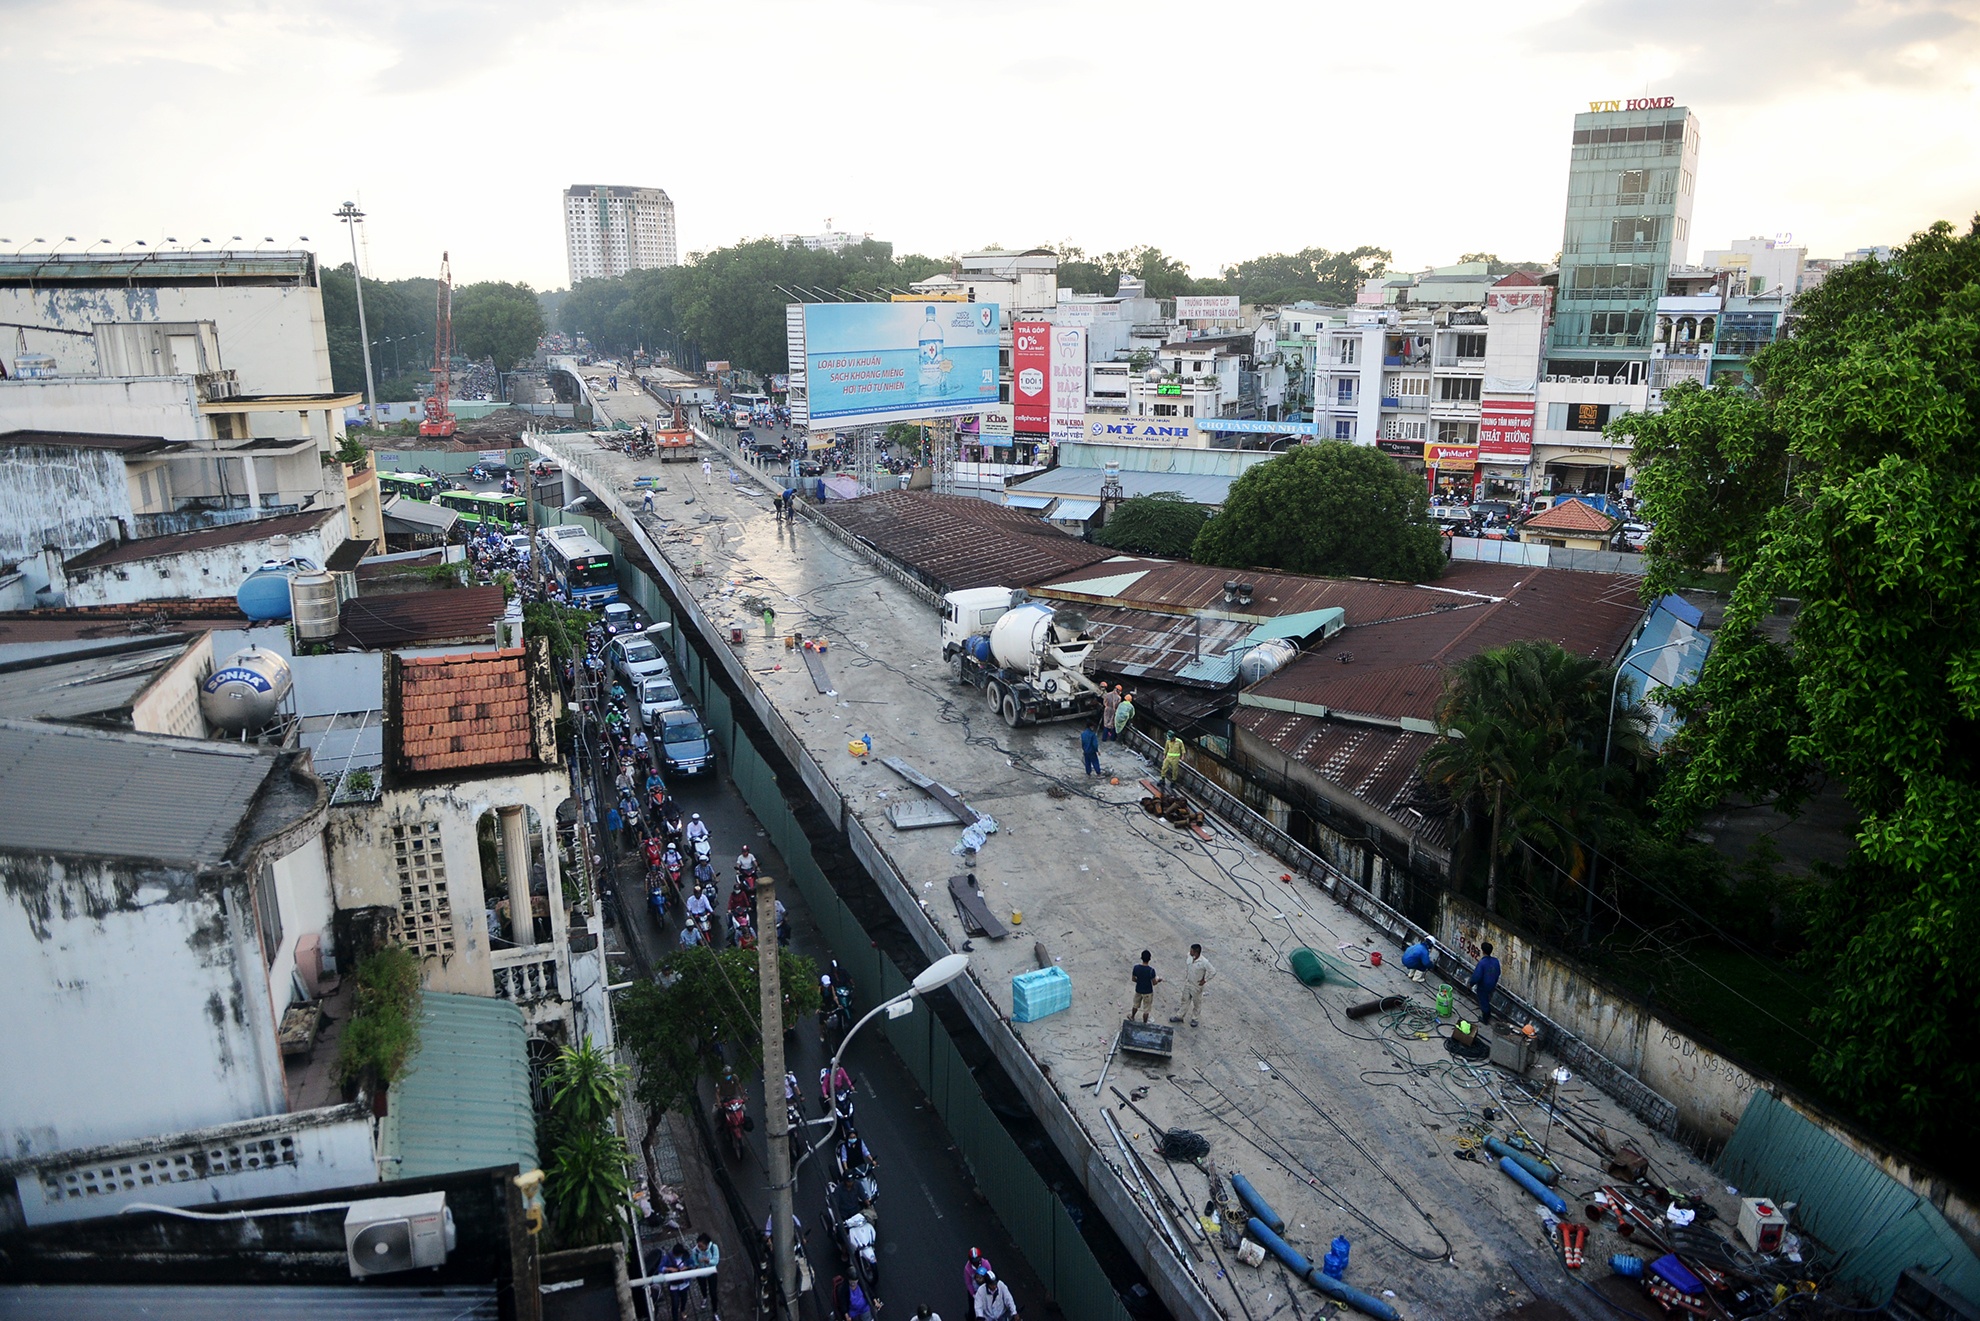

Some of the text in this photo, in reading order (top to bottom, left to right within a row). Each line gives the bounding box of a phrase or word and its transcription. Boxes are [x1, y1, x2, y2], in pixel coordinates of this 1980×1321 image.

[1589, 96, 1675, 112] WIN HOME
[1203, 298, 1219, 306] TRUNG
[1228, 307, 1239, 317] GÒN
[1018, 326, 1045, 334] TRẢ GÓP
[817, 359, 835, 371] LOẠI
[848, 358, 856, 367] VI
[830, 368, 905, 384] SẠCH KHOANG MIỆNG
[843, 385, 857, 395] HƠI
[858, 383, 874, 393] THỞ
[883, 381, 905, 391] NHIÊN
[986, 414, 1007, 423] Kha
[1069, 418, 1084, 426] KHOA
[1482, 417, 1497, 426] TRUNG
[1107, 422, 1189, 437] MỸ ANH
[1198, 421, 1314, 433] CHỢ TÂN SƠN NHẤT
[1069, 431, 1084, 439] VIỆT
[1480, 428, 1501, 443] NHẬT
